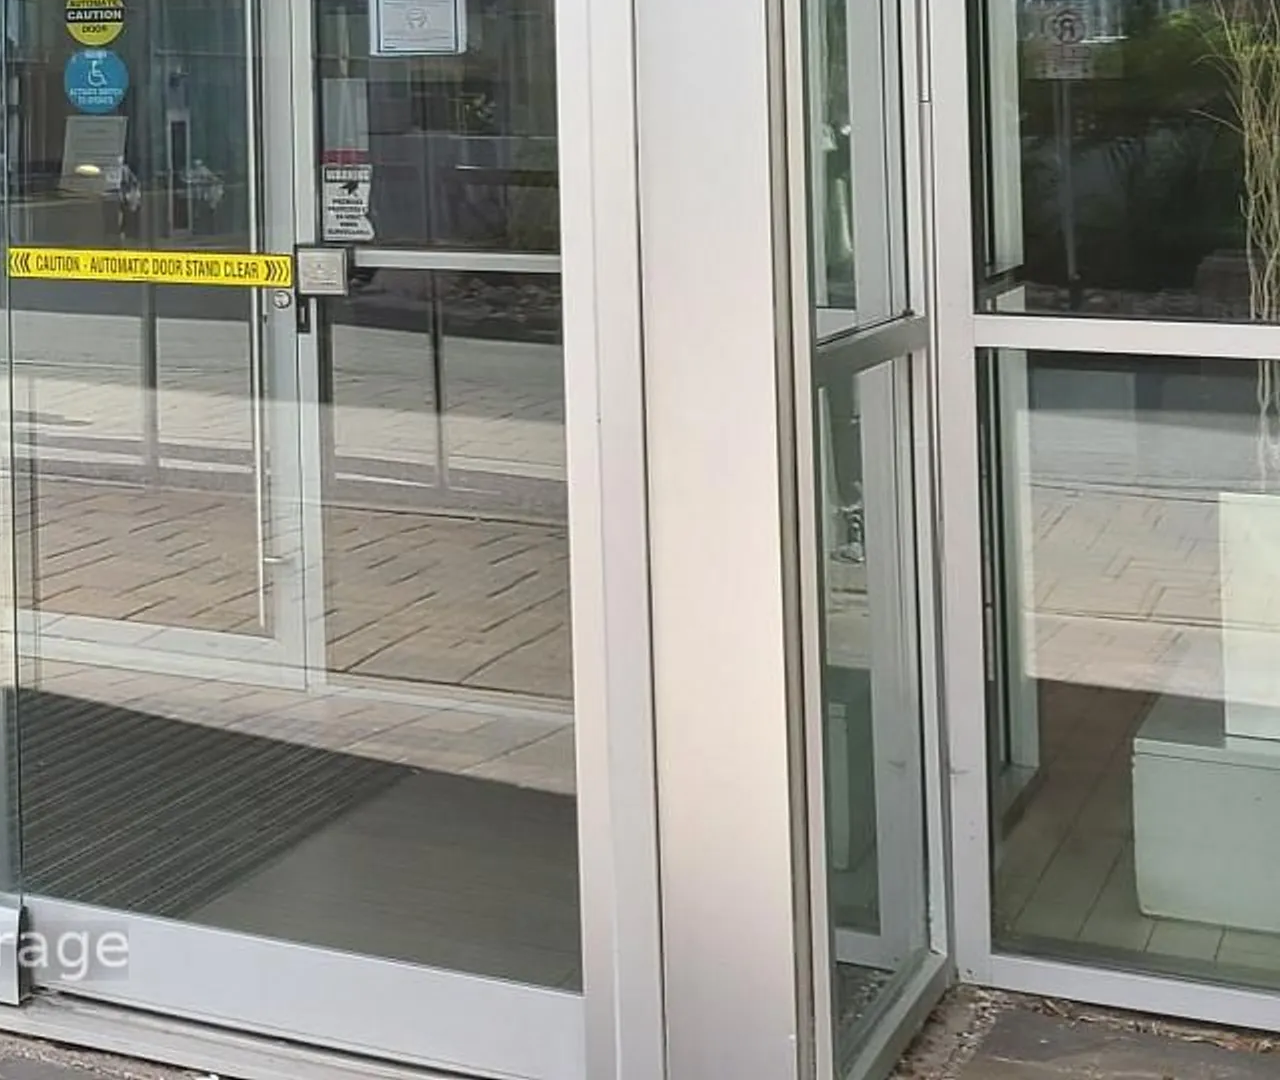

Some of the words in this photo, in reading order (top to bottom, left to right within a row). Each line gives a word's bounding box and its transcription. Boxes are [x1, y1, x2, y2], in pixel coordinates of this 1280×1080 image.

[67, 10, 122, 20] CAUTION
[36, 255, 81, 271] CAUTION
[90, 257, 149, 274] AUTOMATIC
[152, 259, 183, 276] DOOR
[186, 260, 220, 277] STAND
[223, 261, 260, 279] CLEAR
